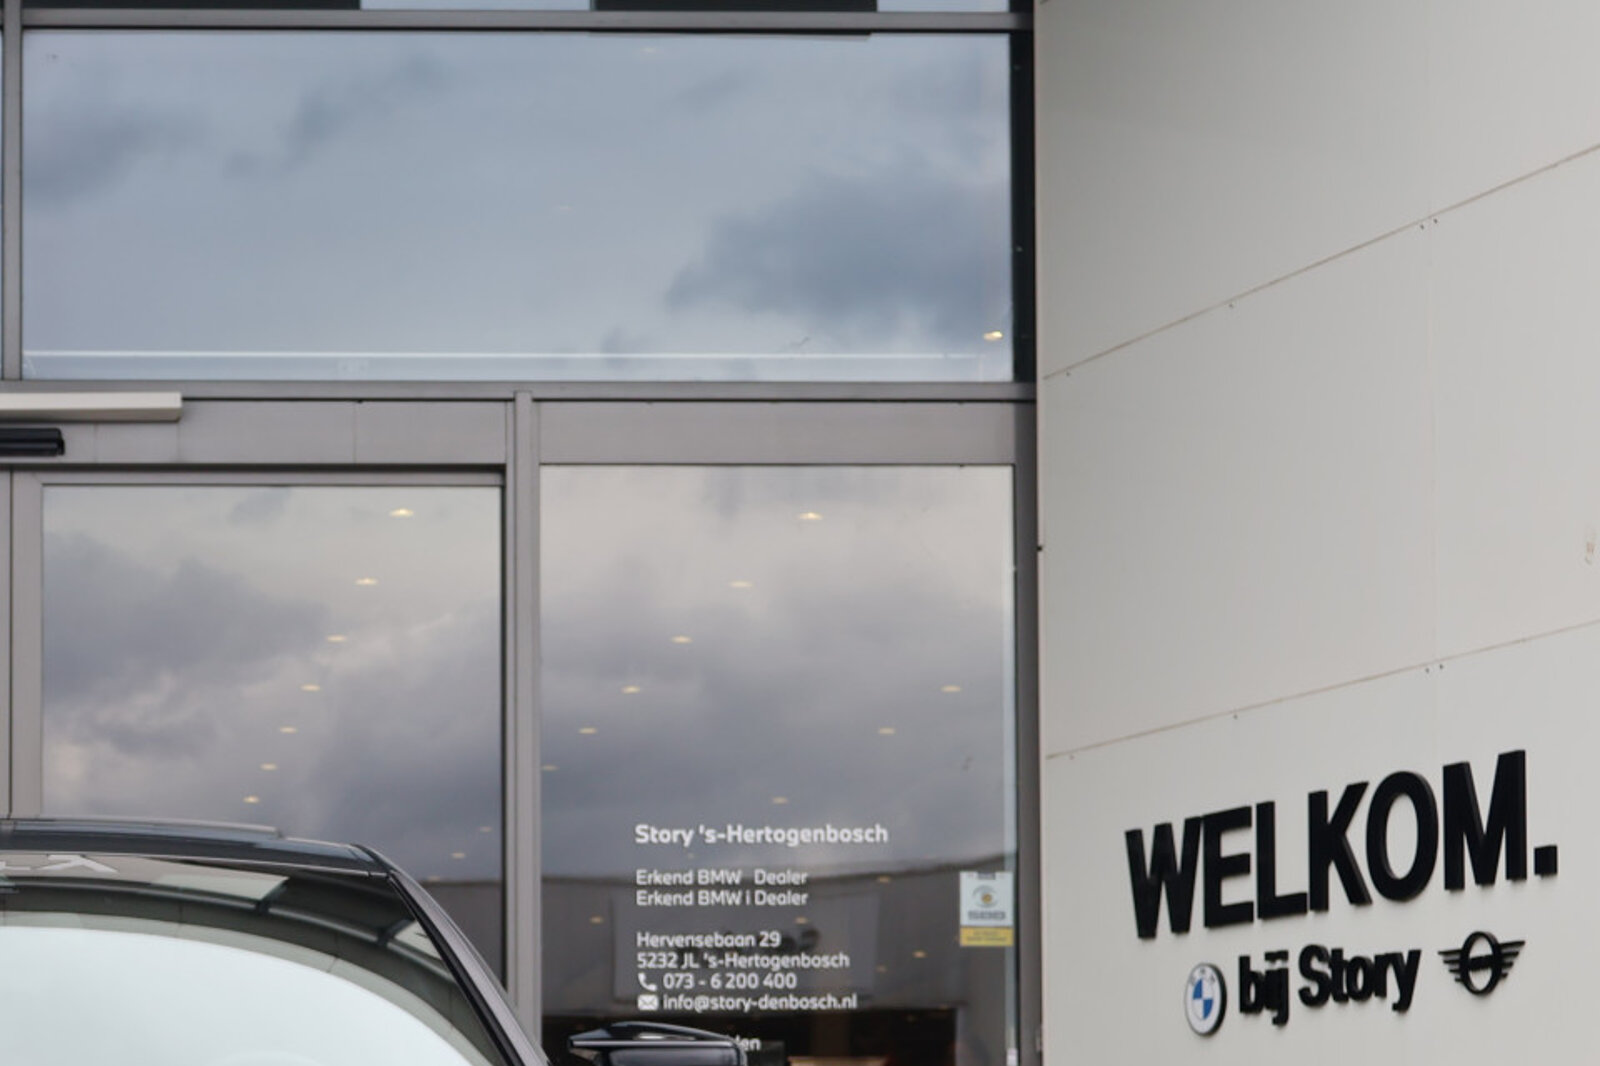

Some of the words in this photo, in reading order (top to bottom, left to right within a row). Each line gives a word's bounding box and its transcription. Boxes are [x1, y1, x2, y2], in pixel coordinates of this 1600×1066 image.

[635, 825, 694, 846] Story
[699, 825, 888, 846] 's-Hertogenbosch
[1125, 749, 1558, 940] WELKOM.
[636, 870, 694, 886] Erkend
[698, 870, 742, 886] BMW
[754, 870, 808, 886] Dealer
[636, 890, 694, 906] Erkend
[698, 890, 742, 906] BMW
[746, 890, 751, 906] i
[754, 890, 808, 906] Dealer
[636, 932, 756, 948] Hervensebaan
[759, 932, 782, 948] 29
[636, 953, 678, 969] 5232
[680, 953, 699, 970] JL
[703, 952, 850, 971] 's-Hertogenbosch
[663, 973, 695, 990] 073
[710, 973, 722, 990] 6
[725, 973, 759, 990] 200
[762, 973, 797, 990] 400
[1298, 944, 1422, 1013] Story
[663, 994, 858, 1013] info@story-denbosch.nl
